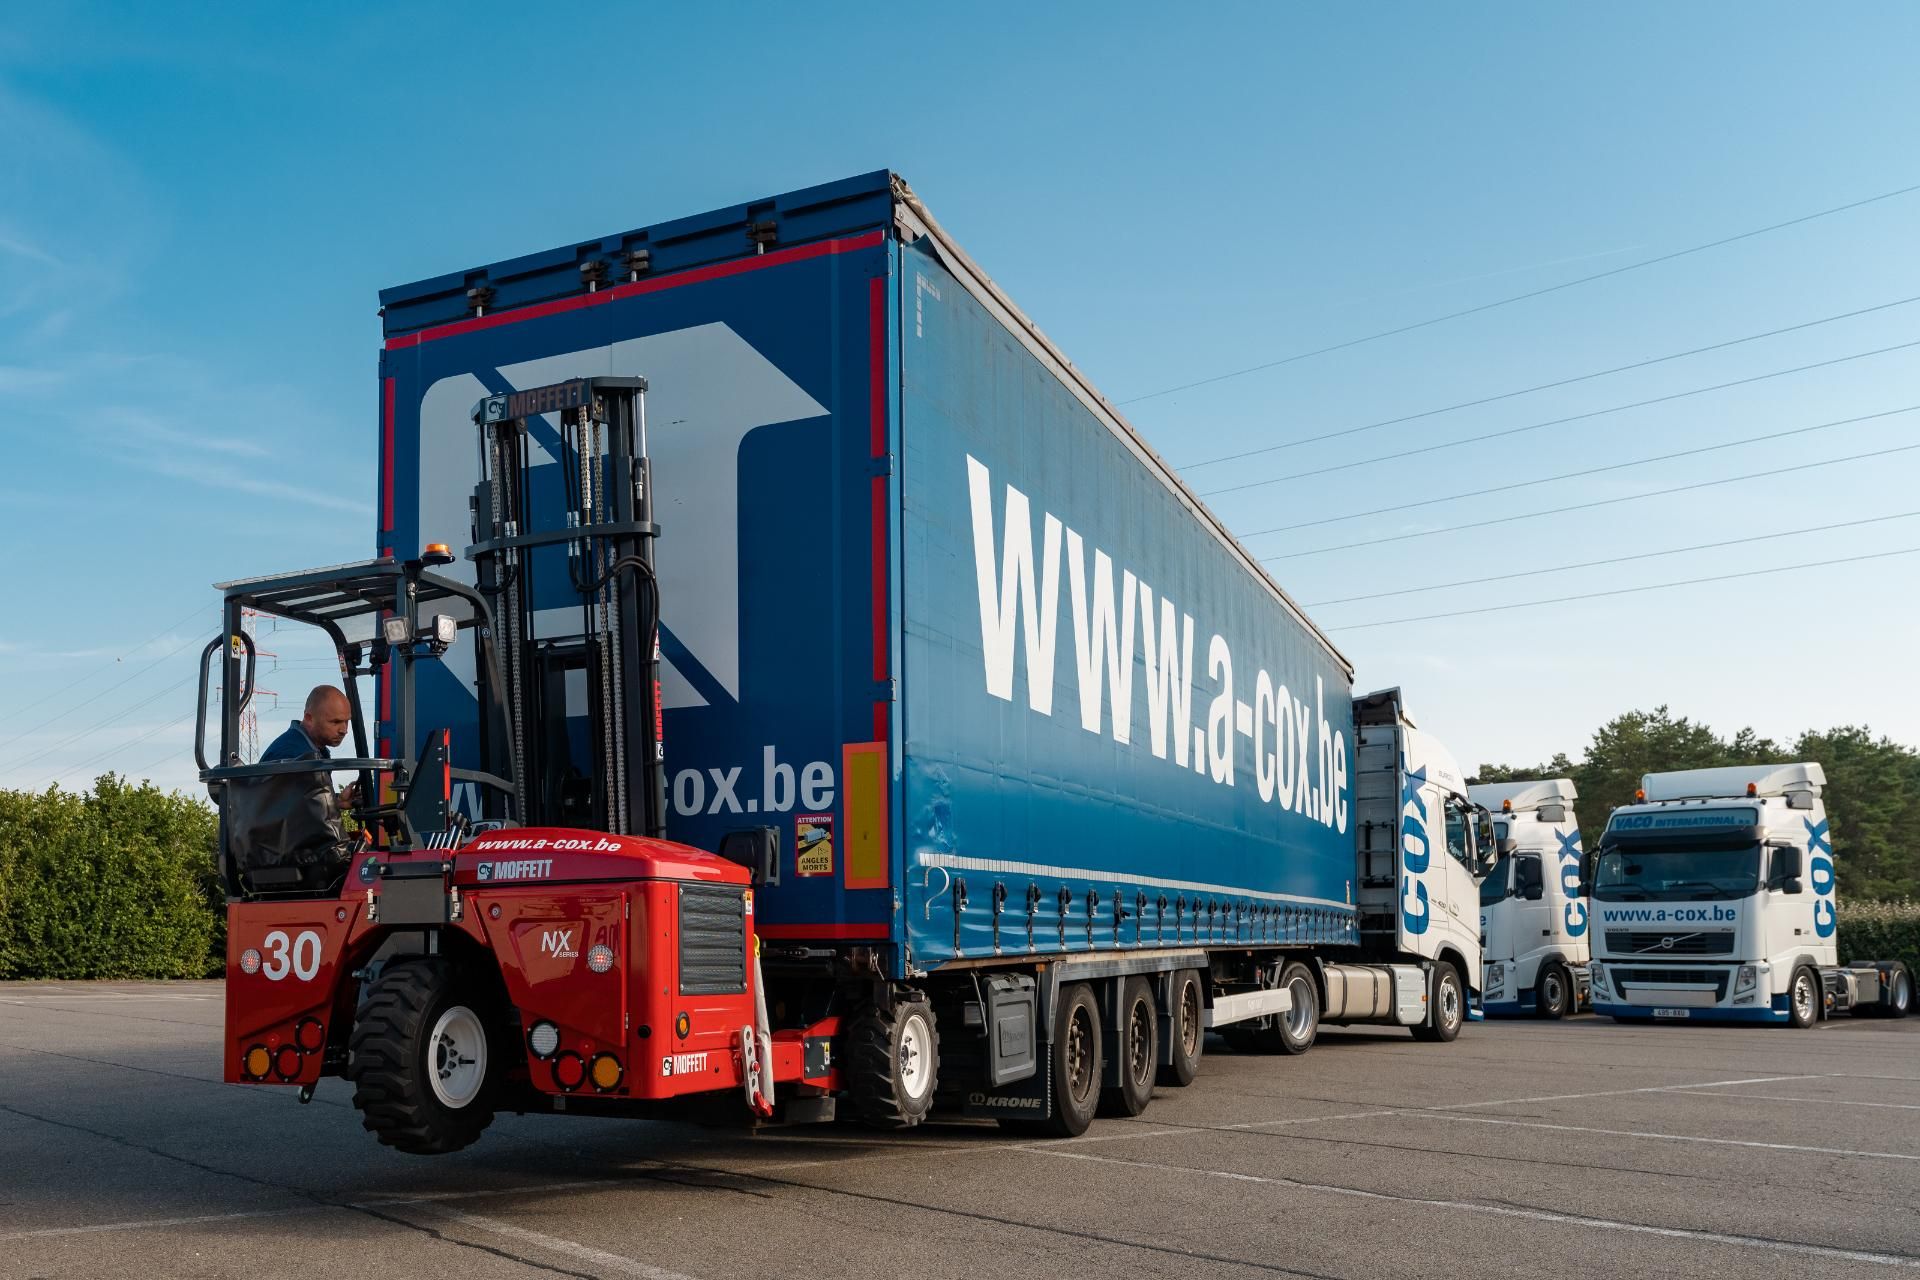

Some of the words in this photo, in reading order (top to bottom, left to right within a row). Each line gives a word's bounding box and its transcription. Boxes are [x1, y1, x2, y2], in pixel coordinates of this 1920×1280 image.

[508, 381, 585, 417] MOFFETT
[966, 453, 1347, 835] www.a-cox.be
[797, 816, 832, 824] ATTENTION
[1615, 815, 1653, 829] VACO
[1655, 816, 1735, 827] INTERNATIONAL
[477, 838, 622, 852] www.a-cox.be
[801, 856, 829, 864] ANGLES
[802, 863, 828, 872] MORTS
[494, 859, 553, 880] MOFFETT
[1603, 905, 1736, 922] www.a-cox.be
[541, 930, 573, 958] NX
[262, 930, 322, 981] 30
[673, 1052, 708, 1075] MOFFETT
[985, 1096, 1043, 1109] KRONE
